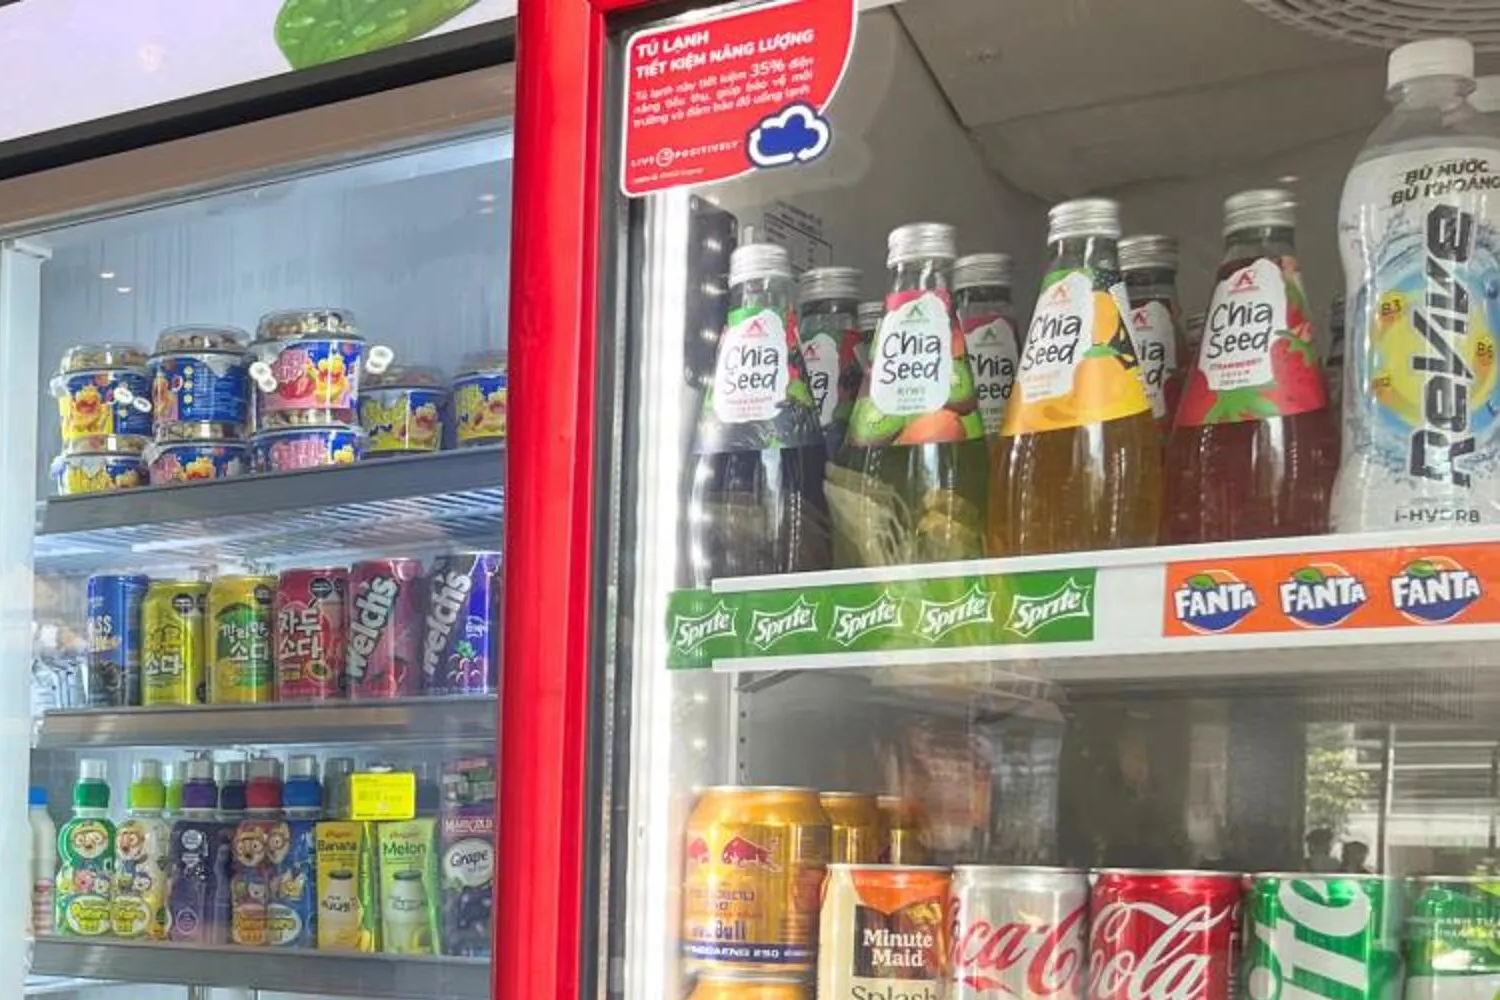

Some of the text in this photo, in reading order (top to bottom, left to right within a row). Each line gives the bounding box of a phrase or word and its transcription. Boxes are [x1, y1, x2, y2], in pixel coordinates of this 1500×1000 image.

[636, 30, 710, 59] TỦ LẠNH
[636, 58, 668, 79] TIẾT
[670, 52, 707, 72] KIỆM
[758, 28, 815, 53] LƯỢNG
[750, 60, 786, 78] 35%
[1029, 313, 1082, 345] Chia
[1211, 301, 1273, 333] Chia
[724, 344, 780, 372] Chia
[882, 329, 942, 360] Chia
[1021, 338, 1079, 371] Seed
[1206, 326, 1273, 359] Seed
[723, 366, 779, 396] Seed
[879, 356, 942, 385] Seed
[756, 606, 811, 643] Sprite
[838, 600, 896, 639] Sprite
[924, 594, 986, 634] Sprite
[1016, 587, 1082, 631] Sprite
[674, 613, 731, 650] Sprite
[383, 840, 427, 856] Melon
[862, 927, 934, 948] Minute
[871, 948, 925, 968] Maid
